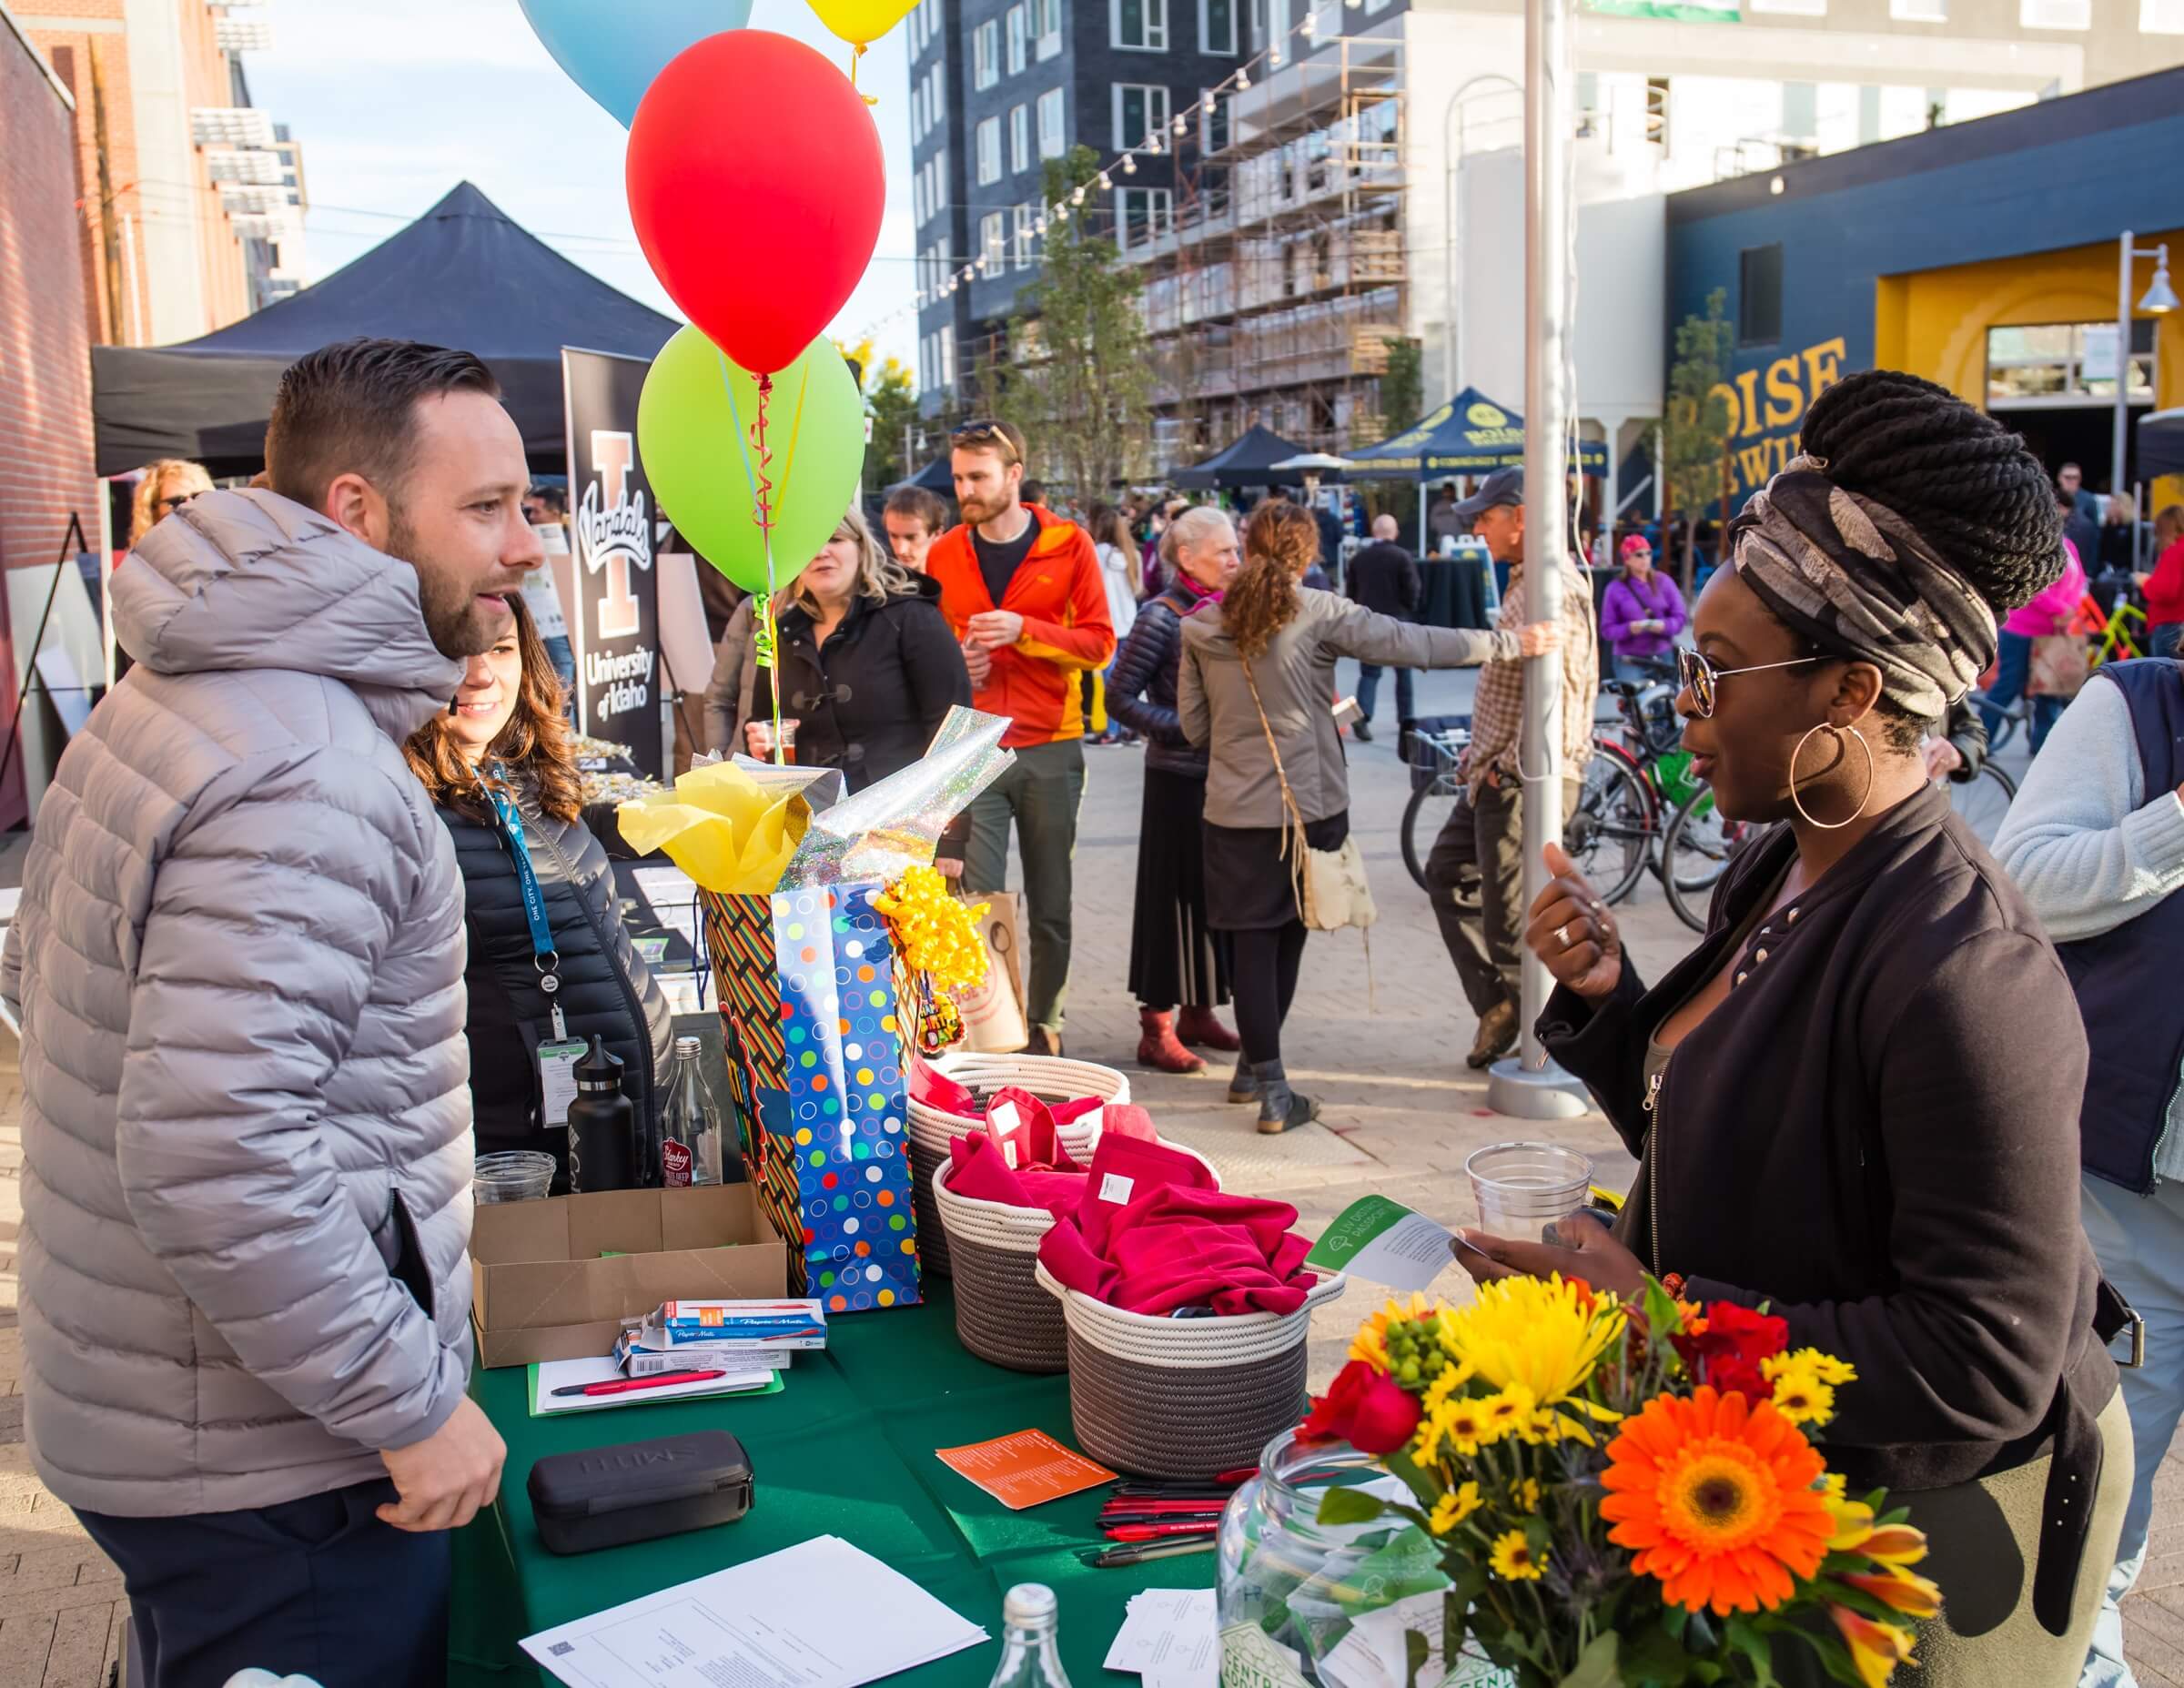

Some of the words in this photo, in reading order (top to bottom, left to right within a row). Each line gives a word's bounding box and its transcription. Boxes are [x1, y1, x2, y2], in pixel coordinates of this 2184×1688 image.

[578, 480, 652, 575] Vandals
[586, 645, 653, 686] University
[597, 690, 611, 723] of
[610, 680, 647, 715] Idaho
[675, 1329, 698, 1339] Paper
[1224, 1647, 1282, 1688] CENTR
